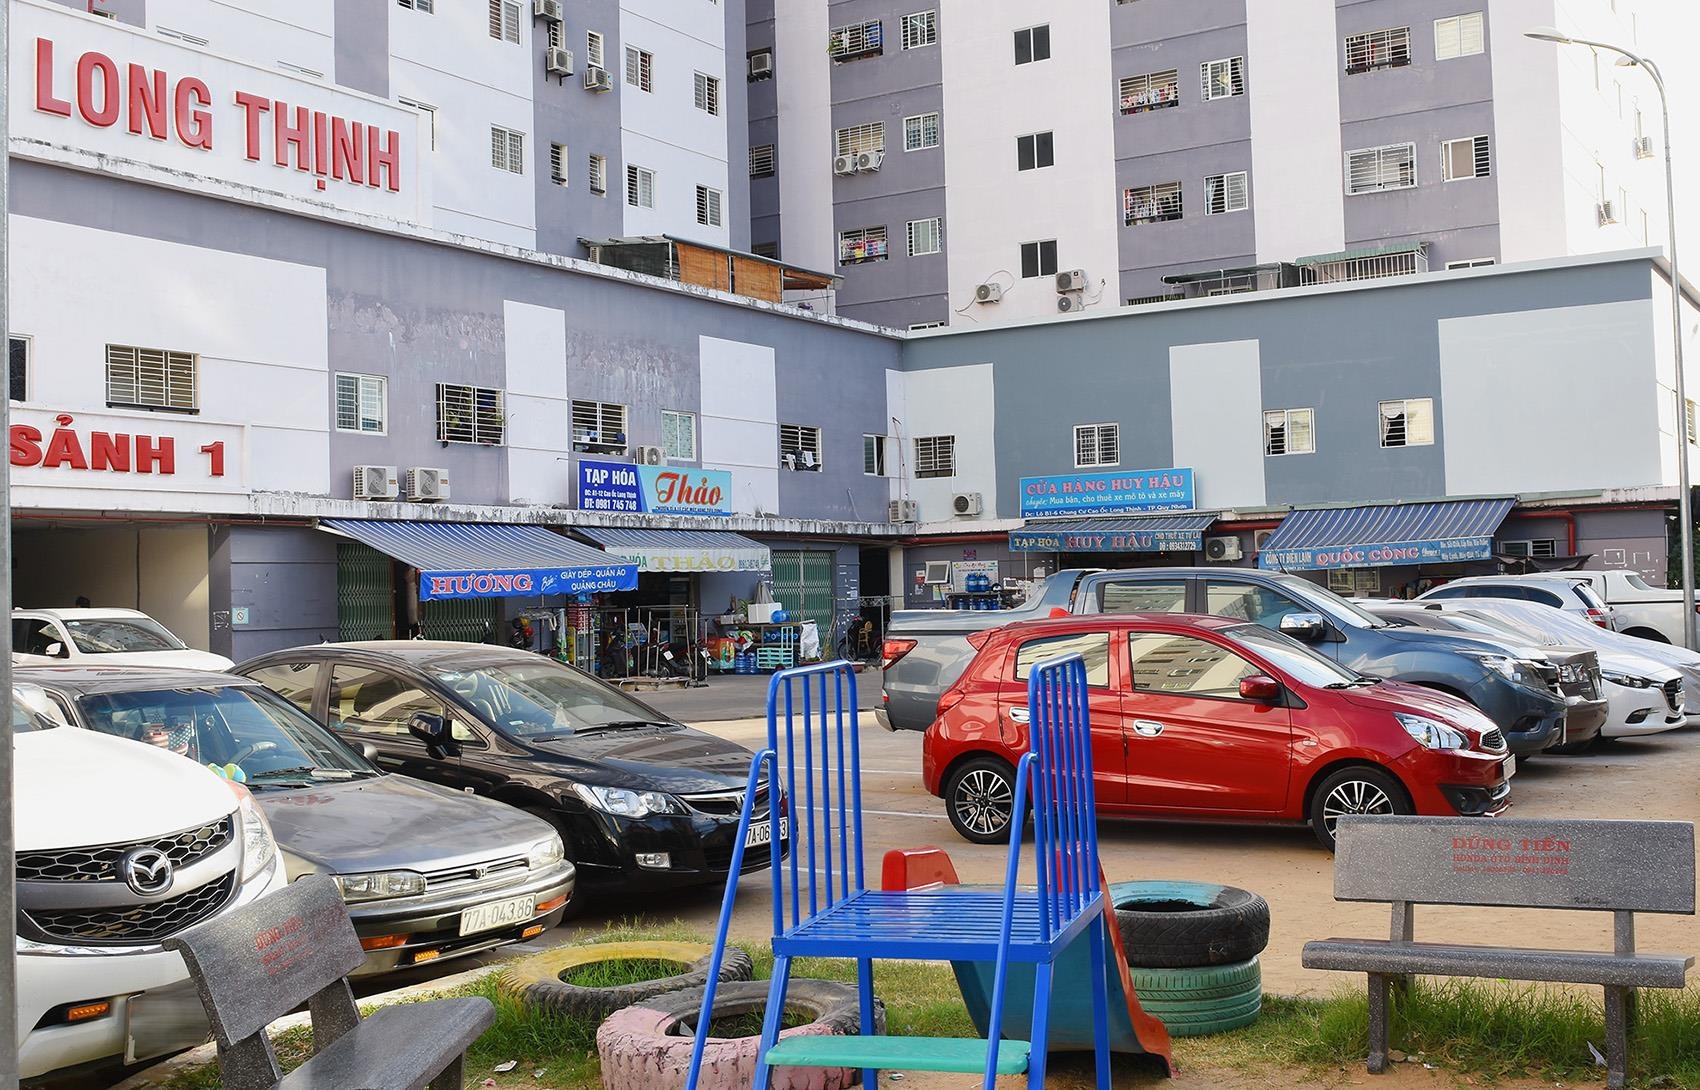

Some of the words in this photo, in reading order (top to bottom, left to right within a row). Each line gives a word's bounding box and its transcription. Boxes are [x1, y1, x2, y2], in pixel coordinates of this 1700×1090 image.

[34, 37, 213, 151] LONG
[234, 91, 400, 192] THỊNH
[10, 414, 175, 475] SẢNH
[199, 441, 225, 476] 1
[585, 468, 608, 487] TẠP
[612, 466, 636, 486] HÓA
[1026, 478, 1058, 495] CỬA
[1062, 478, 1106, 493] HÀNG
[1111, 478, 1144, 490] HUY
[1147, 473, 1184, 491] HẬU
[655, 471, 723, 506] Thảo
[1050, 496, 1064, 504] Mua
[1082, 494, 1095, 503] cho
[1096, 493, 1112, 502] thuê
[1147, 490, 1157, 498] và
[1158, 490, 1167, 498] xe
[1169, 490, 1185, 499] máy
[612, 499, 624, 510] 745
[1014, 537, 1035, 547] TẠP
[1037, 536, 1060, 547] HÓA
[1066, 536, 1105, 549] HUY
[1111, 532, 1152, 550] HẬU
[1155, 532, 1165, 540] CHO
[651, 551, 736, 570] THẢO
[1315, 544, 1365, 566] QUỐC
[1368, 546, 1419, 561] CÔNG
[430, 573, 533, 594] HƯƠNG
[1453, 853, 1487, 863] HONDA
[464, 898, 533, 932] 77A-043.86
